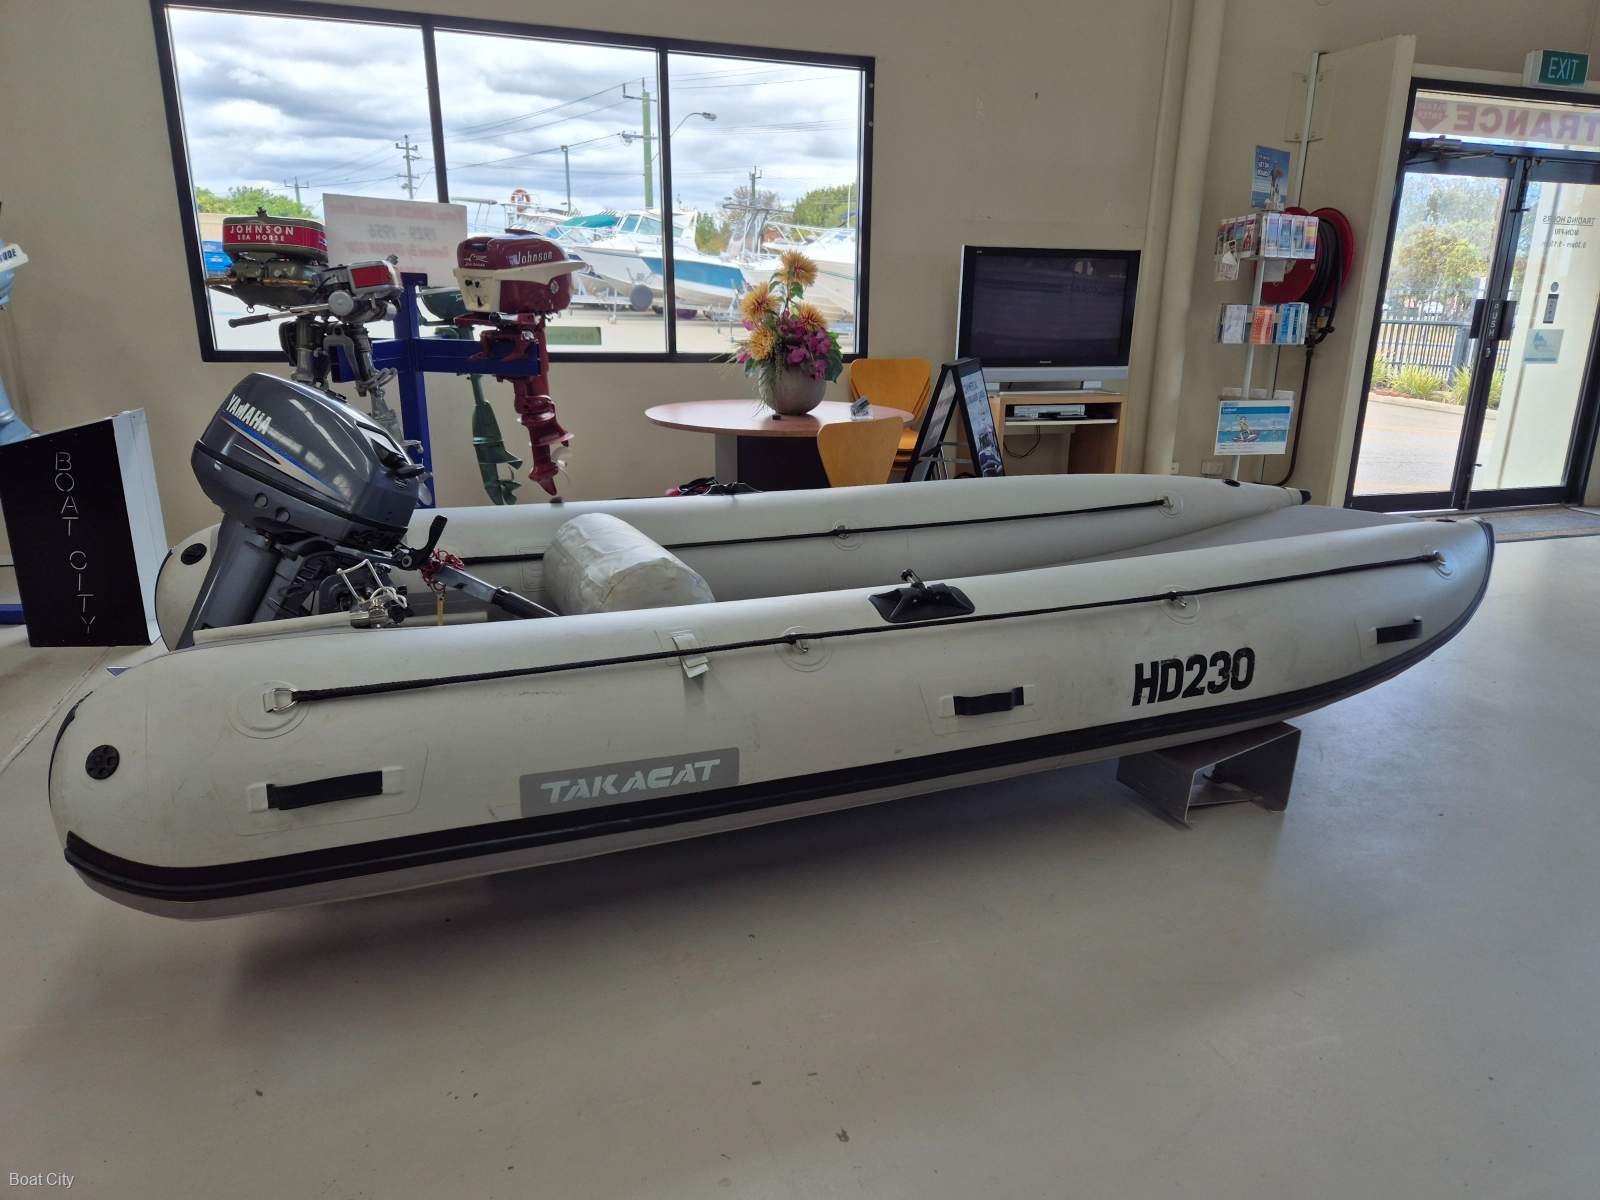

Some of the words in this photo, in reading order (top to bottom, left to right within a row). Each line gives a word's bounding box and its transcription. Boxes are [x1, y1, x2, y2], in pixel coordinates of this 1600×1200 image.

[1548, 57, 1580, 80] EXIT
[230, 224, 295, 236] JOHNSON
[0, 248, 17, 263] UDE
[515, 251, 553, 265] Johnson
[1488, 303, 1499, 336] PUSH
[226, 394, 272, 435] YAMAHA
[54, 451, 80, 537] BOAT
[69, 550, 96, 634] CITY
[1131, 647, 1256, 707] HD230
[540, 758, 721, 804] TAKACAT
